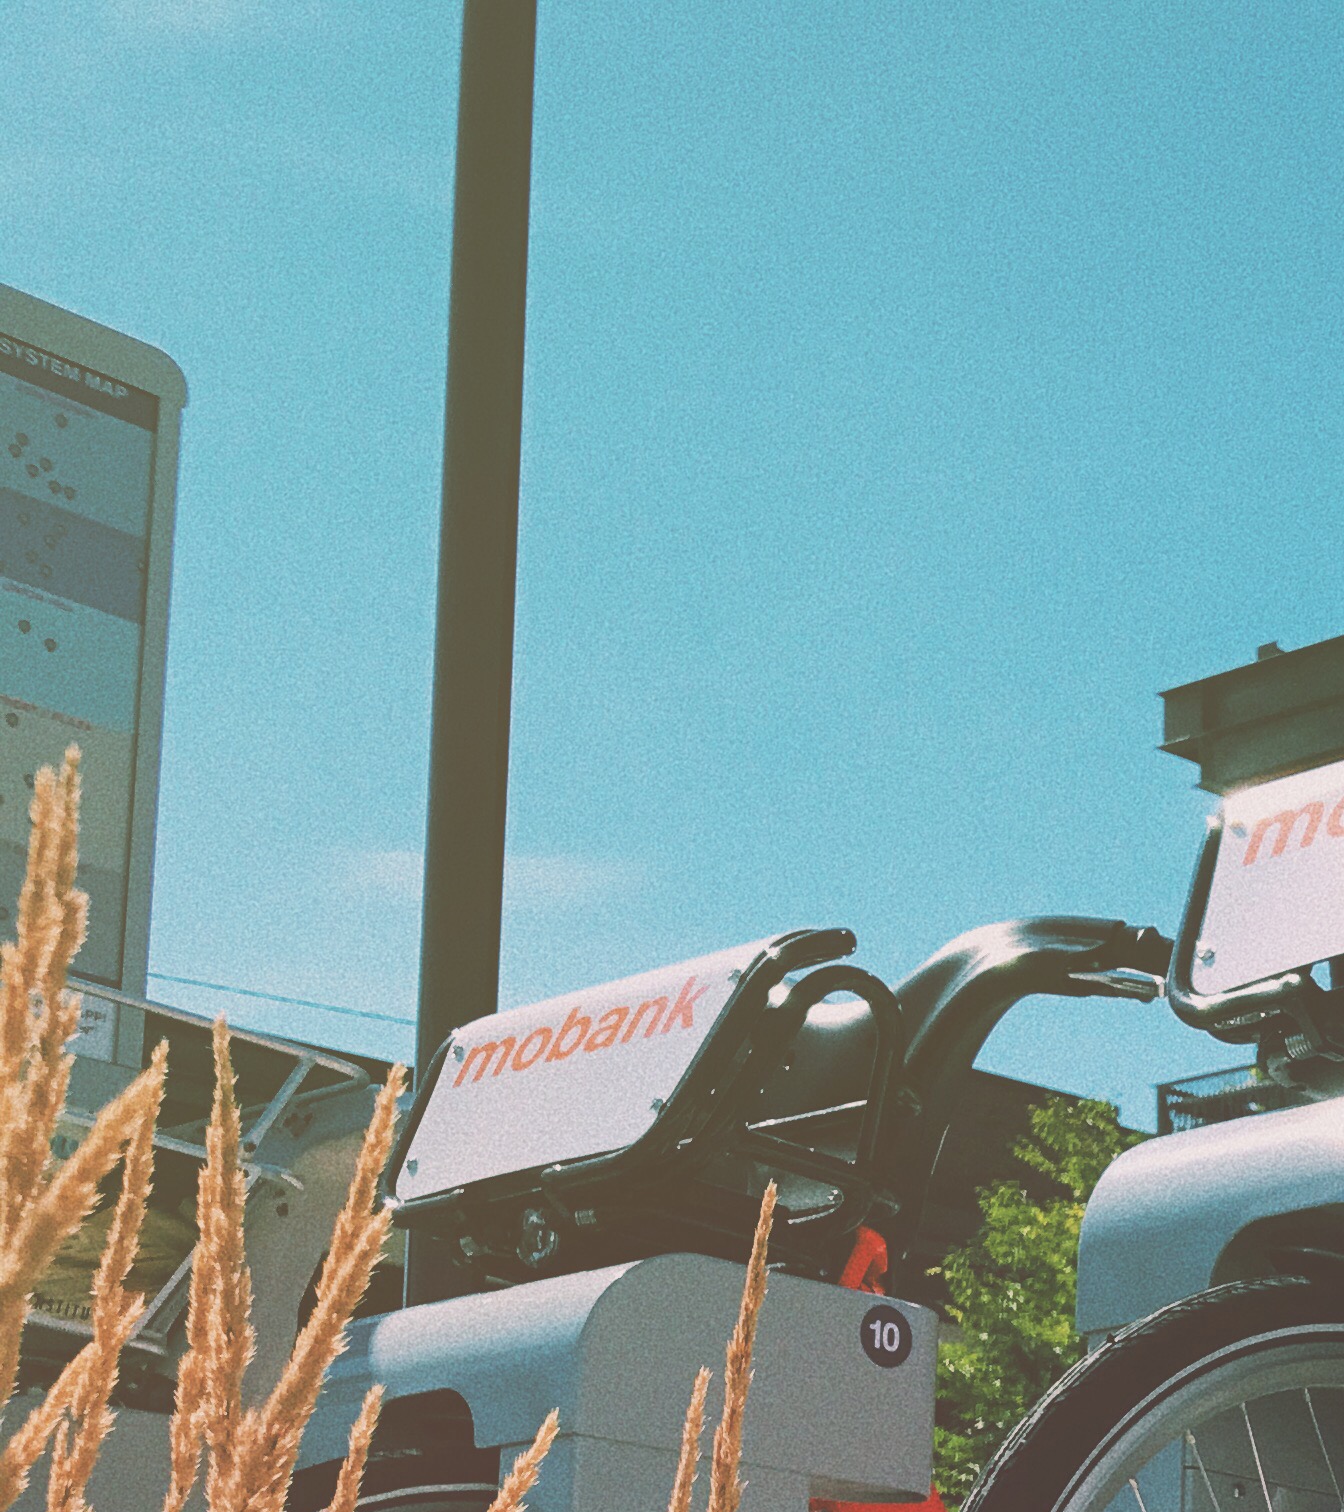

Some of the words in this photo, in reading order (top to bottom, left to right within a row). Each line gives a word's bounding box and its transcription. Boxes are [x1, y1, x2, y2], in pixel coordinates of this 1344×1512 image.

[0, 337, 80, 382] SYSTEM
[84, 372, 129, 399] MAP
[453, 976, 710, 1088] mobank
[869, 1319, 900, 1352] 10
